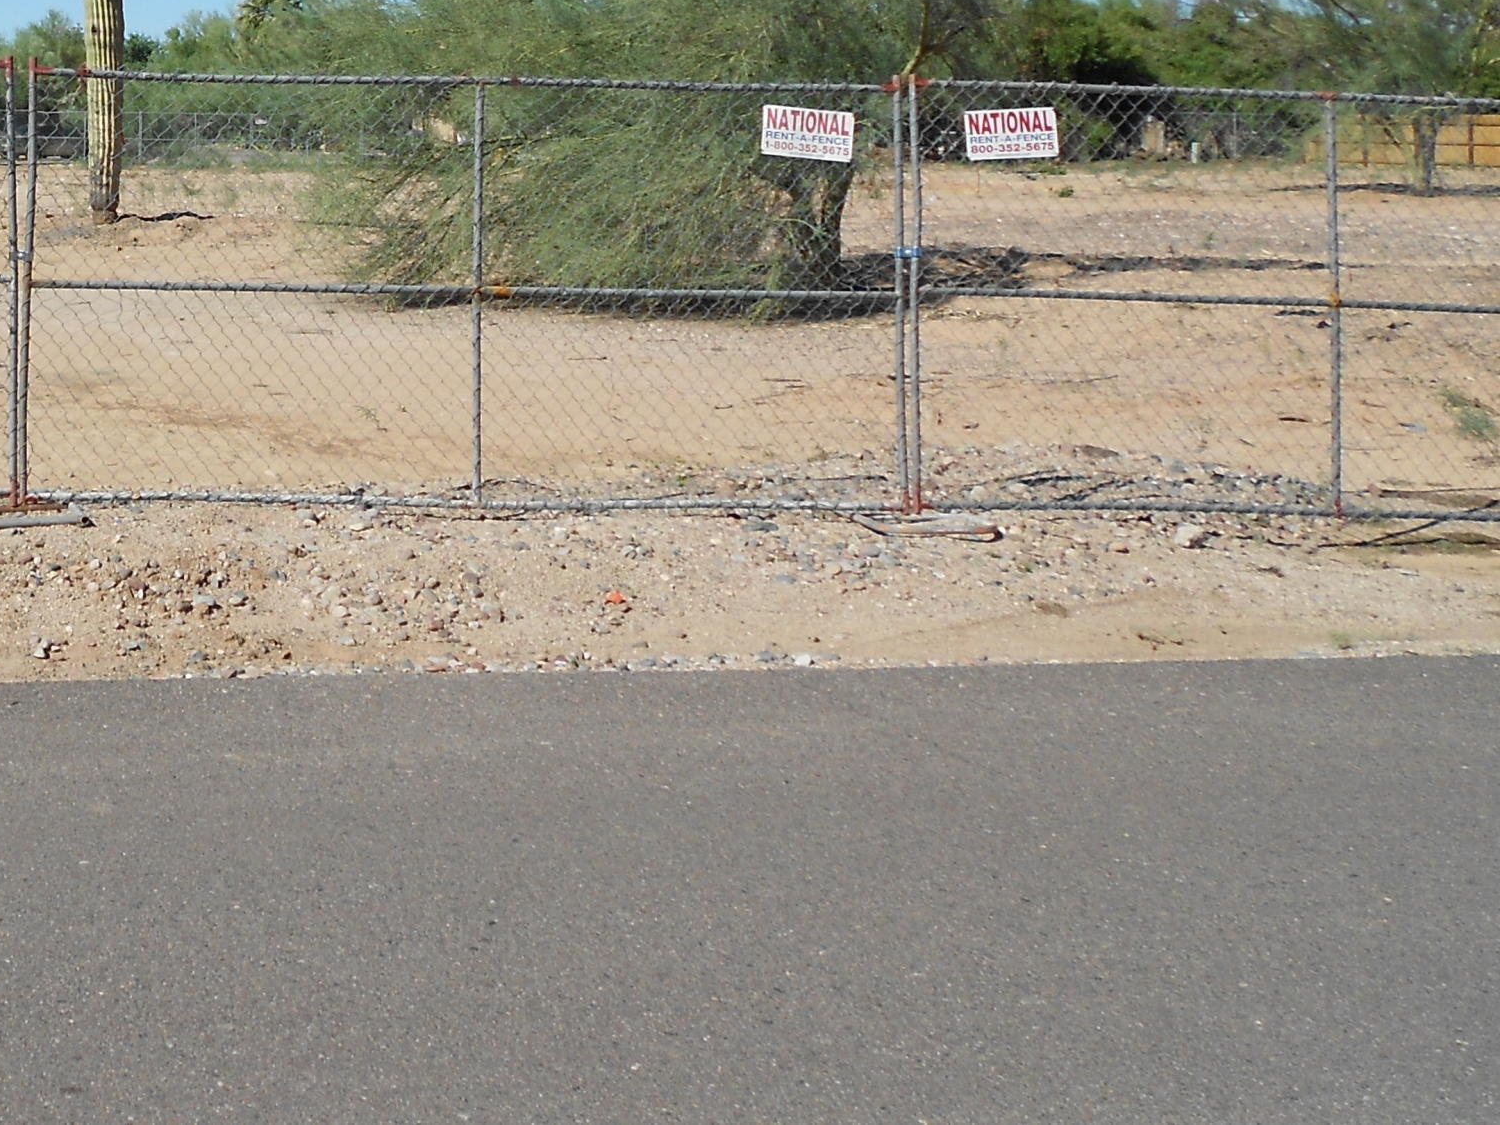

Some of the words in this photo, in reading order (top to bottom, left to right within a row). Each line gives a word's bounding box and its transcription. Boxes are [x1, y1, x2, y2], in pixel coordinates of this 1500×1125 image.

[767, 108, 850, 136] NATIONAL
[968, 110, 1053, 135] NATIONAL
[765, 130, 850, 146] RENT-A-FENCE
[970, 133, 1055, 144] RENT-A-FENCE
[765, 141, 850, 156] 1-800-352-5675
[971, 142, 1055, 154] 800-352-5675
